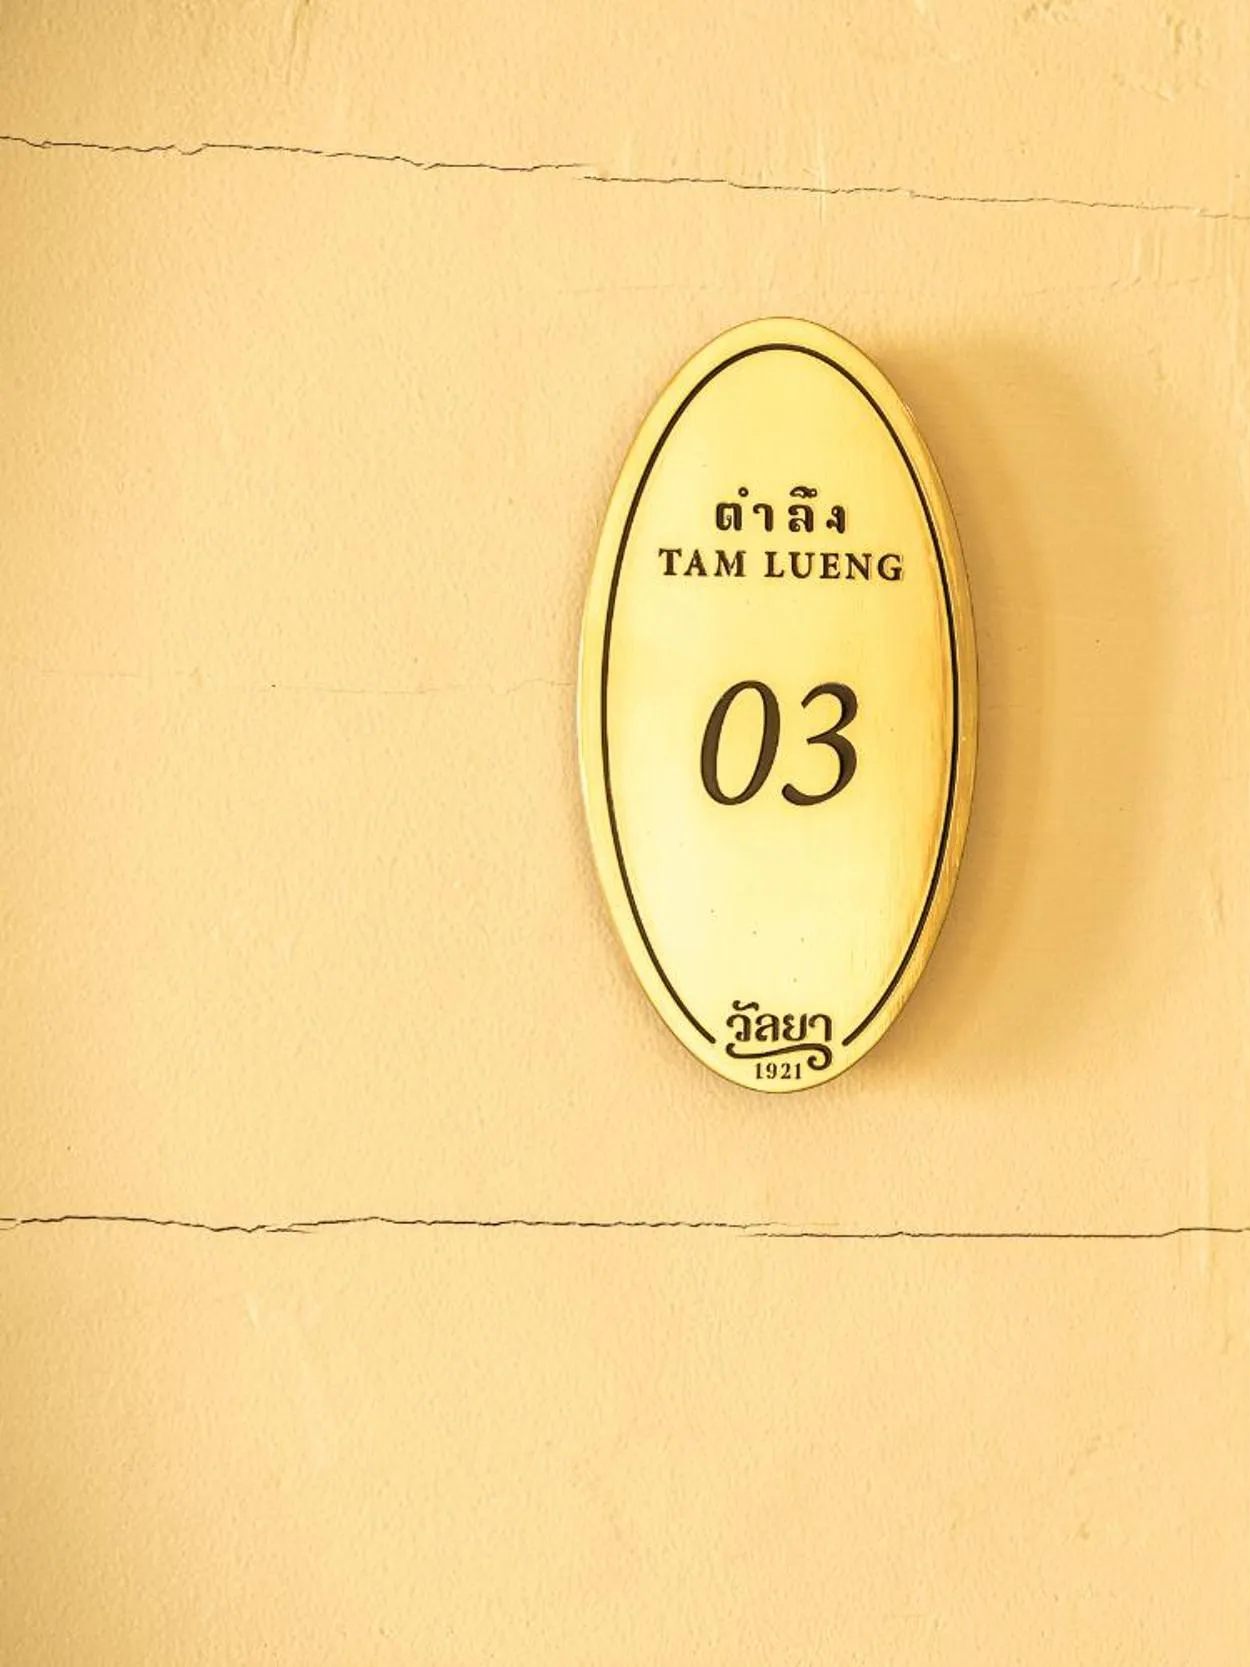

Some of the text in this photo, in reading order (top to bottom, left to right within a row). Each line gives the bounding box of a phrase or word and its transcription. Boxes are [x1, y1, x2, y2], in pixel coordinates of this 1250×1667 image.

[715, 486, 846, 534] ตำลึง
[658, 548, 904, 581] TAM LUENG
[700, 680, 858, 806] 03
[726, 1000, 833, 1042] วัลยา
[755, 1062, 802, 1080] 1921
